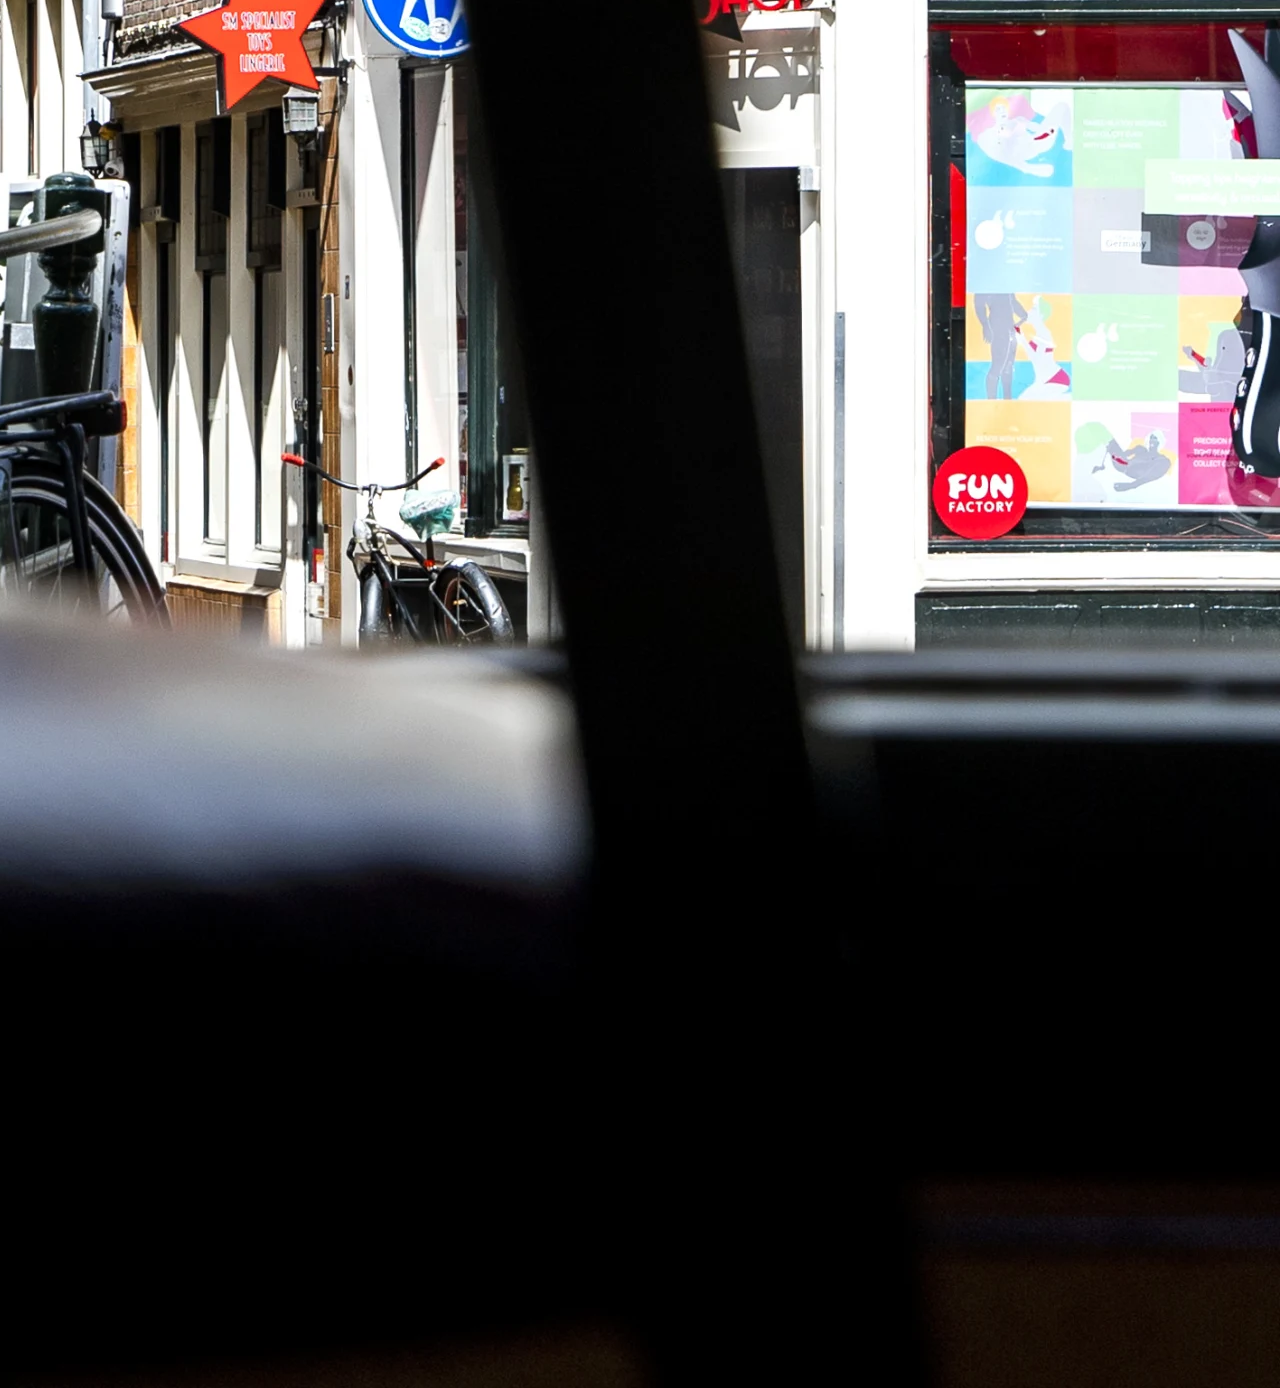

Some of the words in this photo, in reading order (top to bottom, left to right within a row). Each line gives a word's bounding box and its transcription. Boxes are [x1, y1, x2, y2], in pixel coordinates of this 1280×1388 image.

[221, 11, 238, 30] SM
[240, 10, 296, 30] SPECIALIST
[246, 32, 273, 52] TOYS
[239, 53, 286, 72] LINGERIE
[1105, 239, 1148, 250] Germany
[1193, 460, 1221, 468] COLLECT
[947, 473, 1014, 500] FUN
[948, 501, 1014, 513] FACTORY
